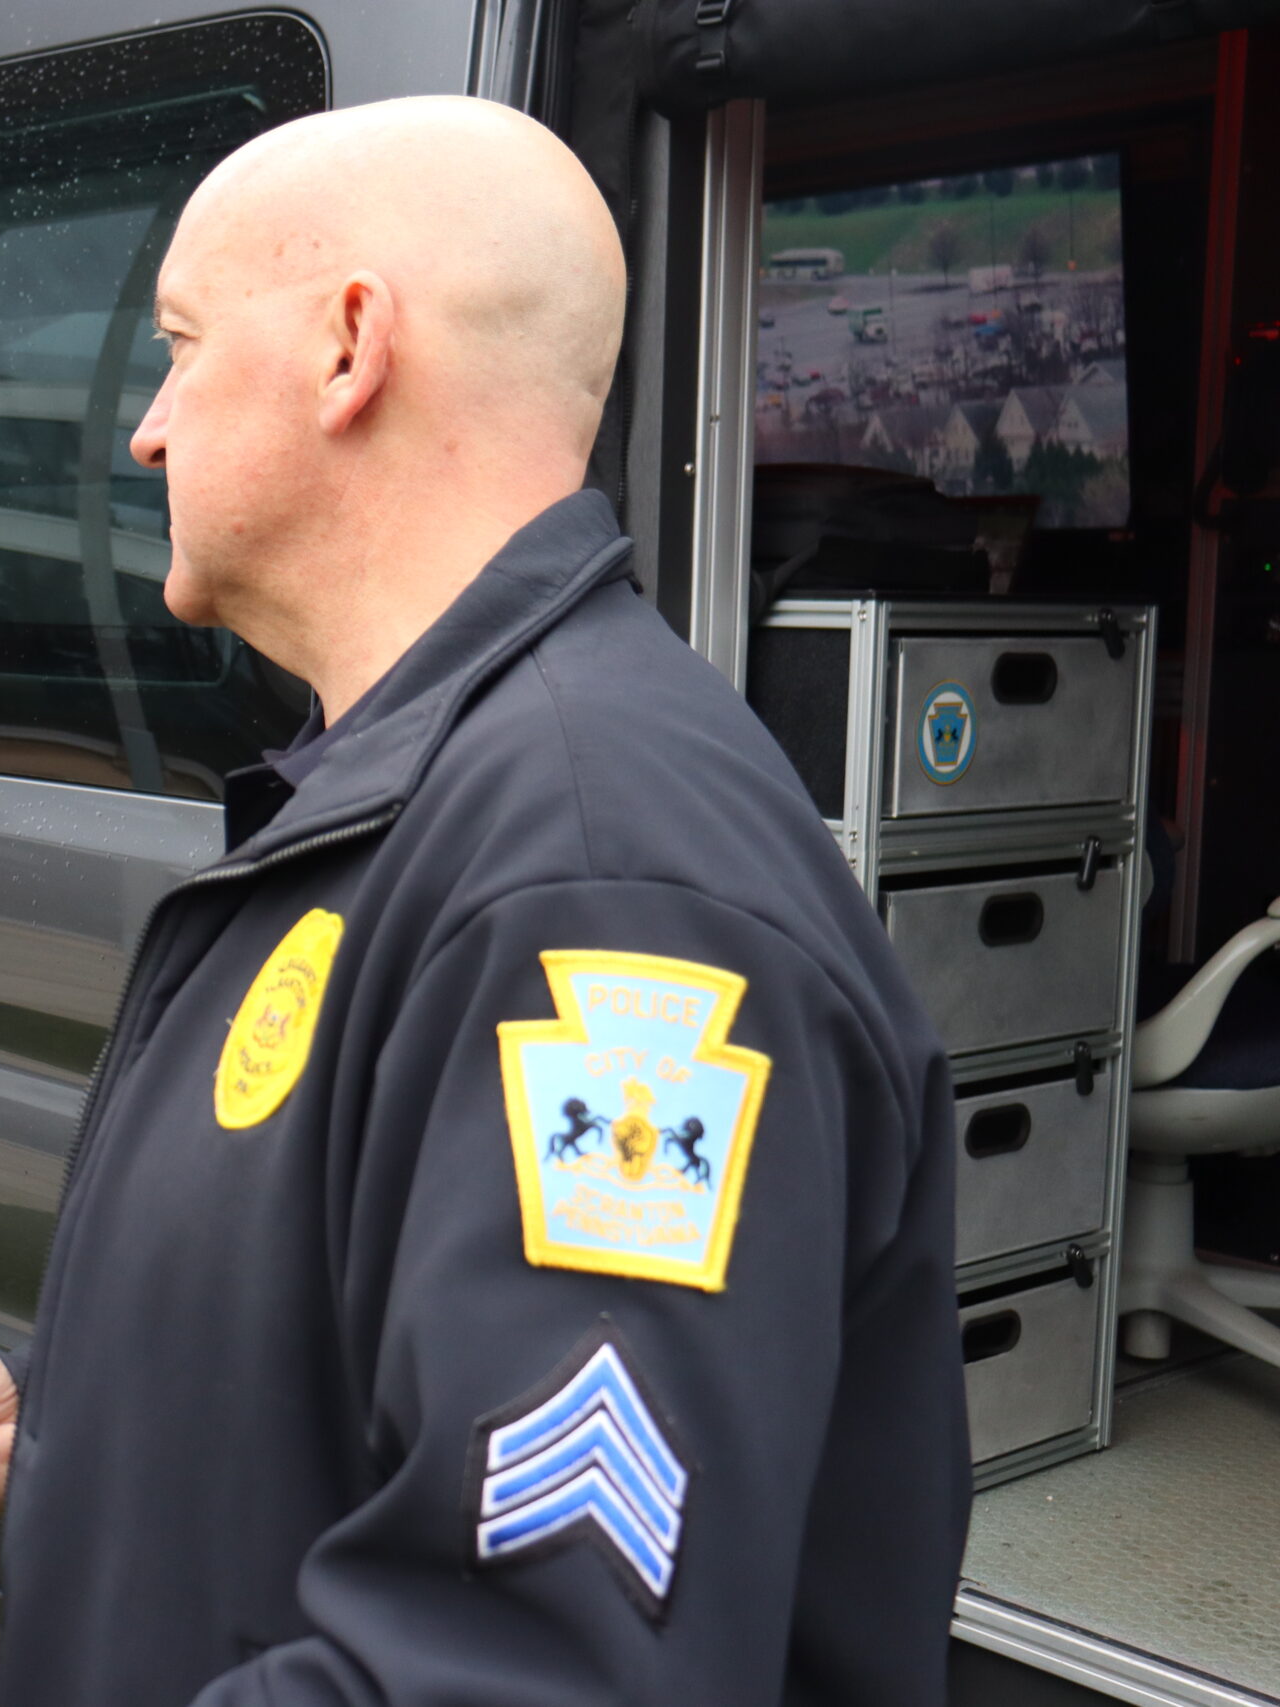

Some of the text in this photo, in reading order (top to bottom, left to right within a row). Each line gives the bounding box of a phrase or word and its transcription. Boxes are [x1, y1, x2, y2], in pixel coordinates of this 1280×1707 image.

[588, 983, 702, 1028] POLICE
[584, 1048, 693, 1083] CITY OF
